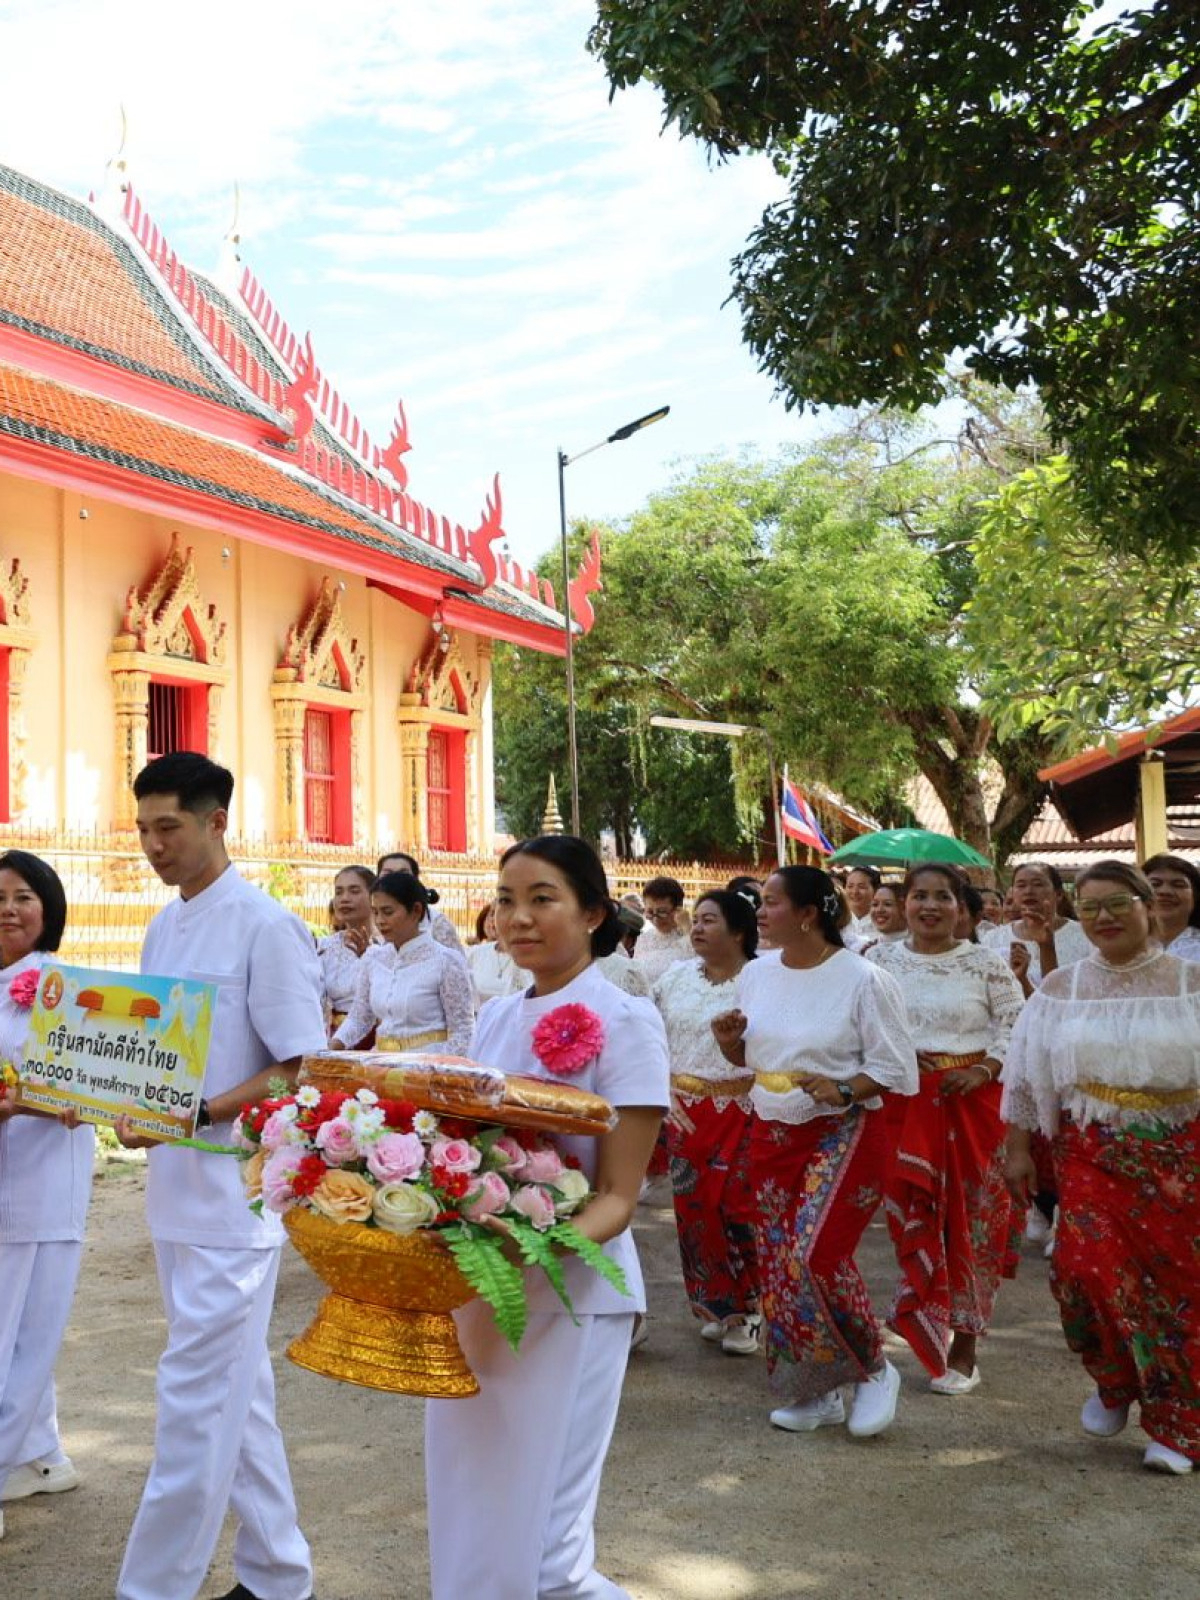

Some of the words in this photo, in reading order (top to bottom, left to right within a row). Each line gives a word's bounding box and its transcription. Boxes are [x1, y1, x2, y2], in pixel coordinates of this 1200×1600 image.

[46, 1024, 178, 1071] กฐินสามัคคีทั่วไทย
[144, 1081, 194, 1108] ๒๕๖๘
